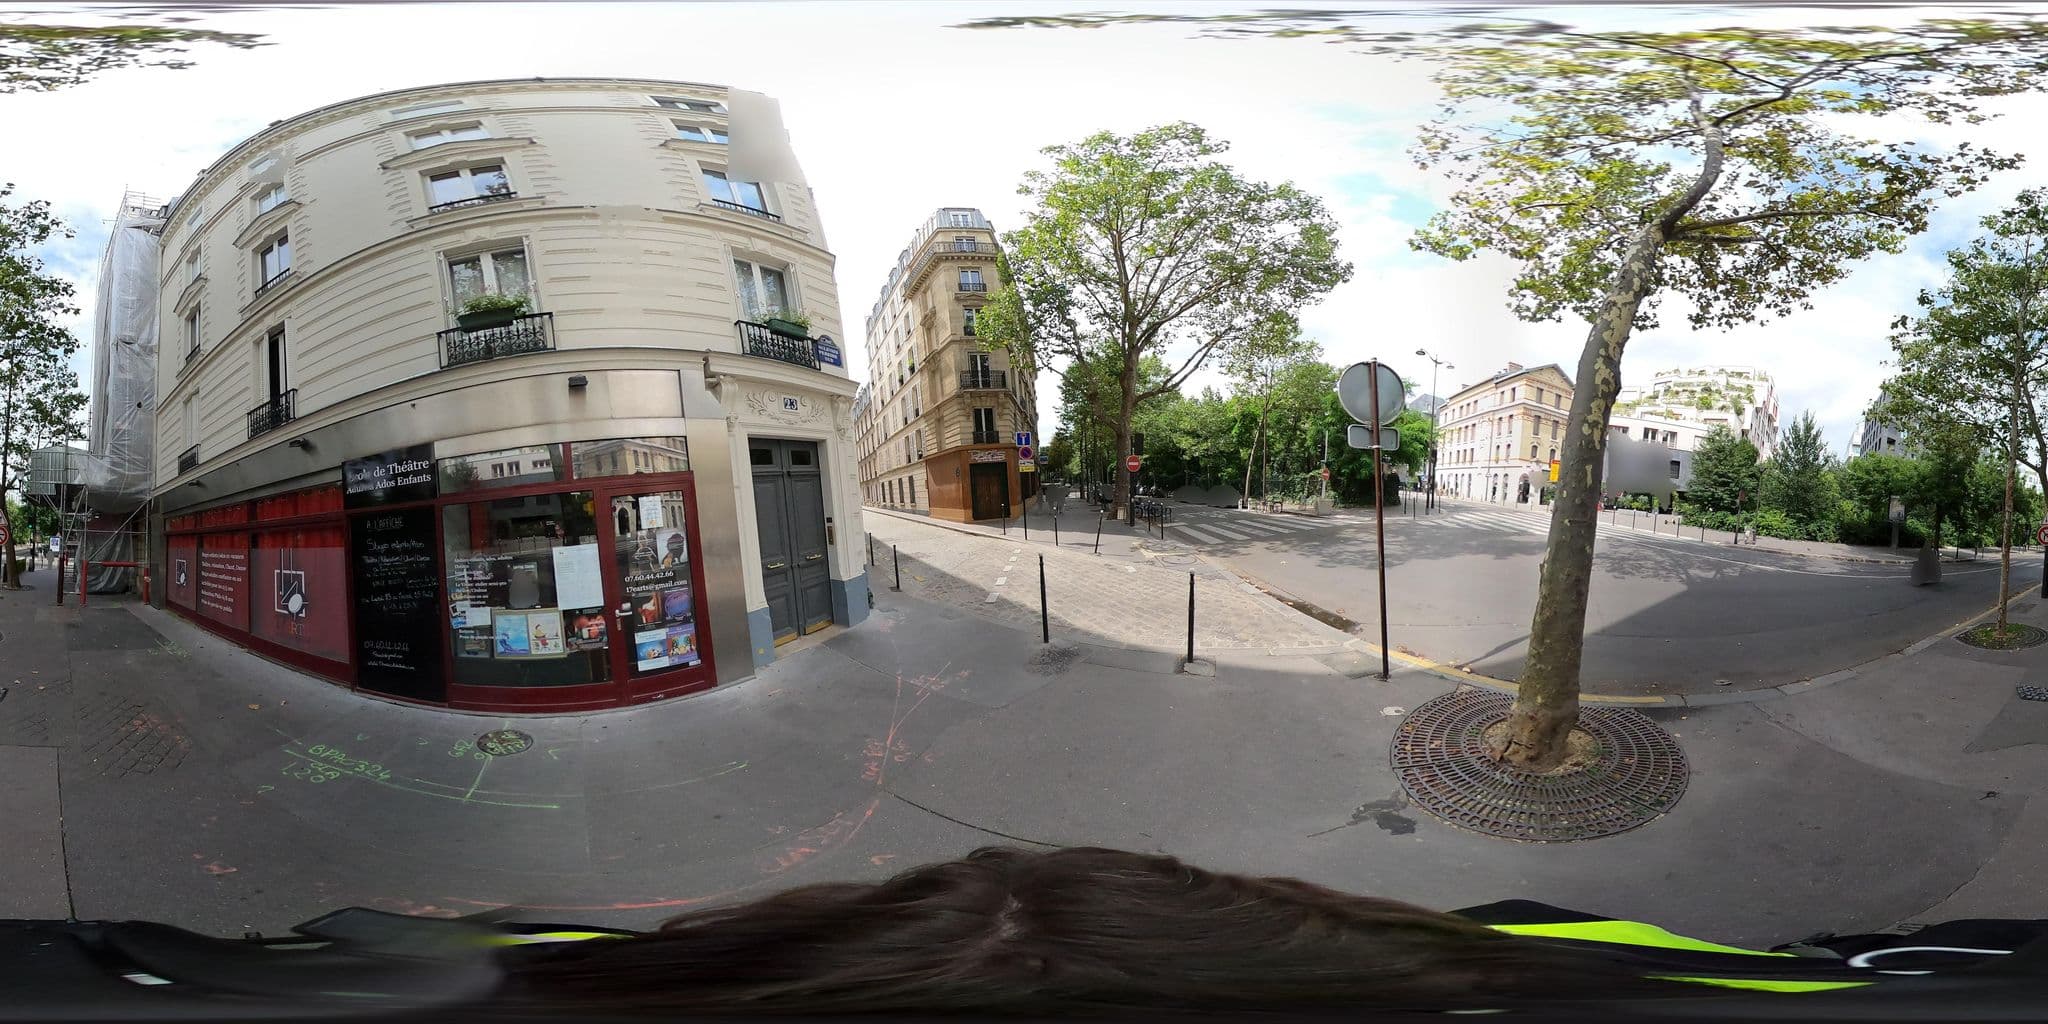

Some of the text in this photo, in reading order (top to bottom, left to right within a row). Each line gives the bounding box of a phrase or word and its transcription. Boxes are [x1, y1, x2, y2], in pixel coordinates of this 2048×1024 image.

[785, 398, 796, 410] 23
[374, 466, 386, 478] de
[387, 460, 430, 475] Théâtre
[375, 478, 396, 490] Ados
[397, 474, 432, 486] Enfants
[624, 571, 674, 582] 07.60.44.42.66
[626, 580, 688, 592] 17earts@gmail.com
